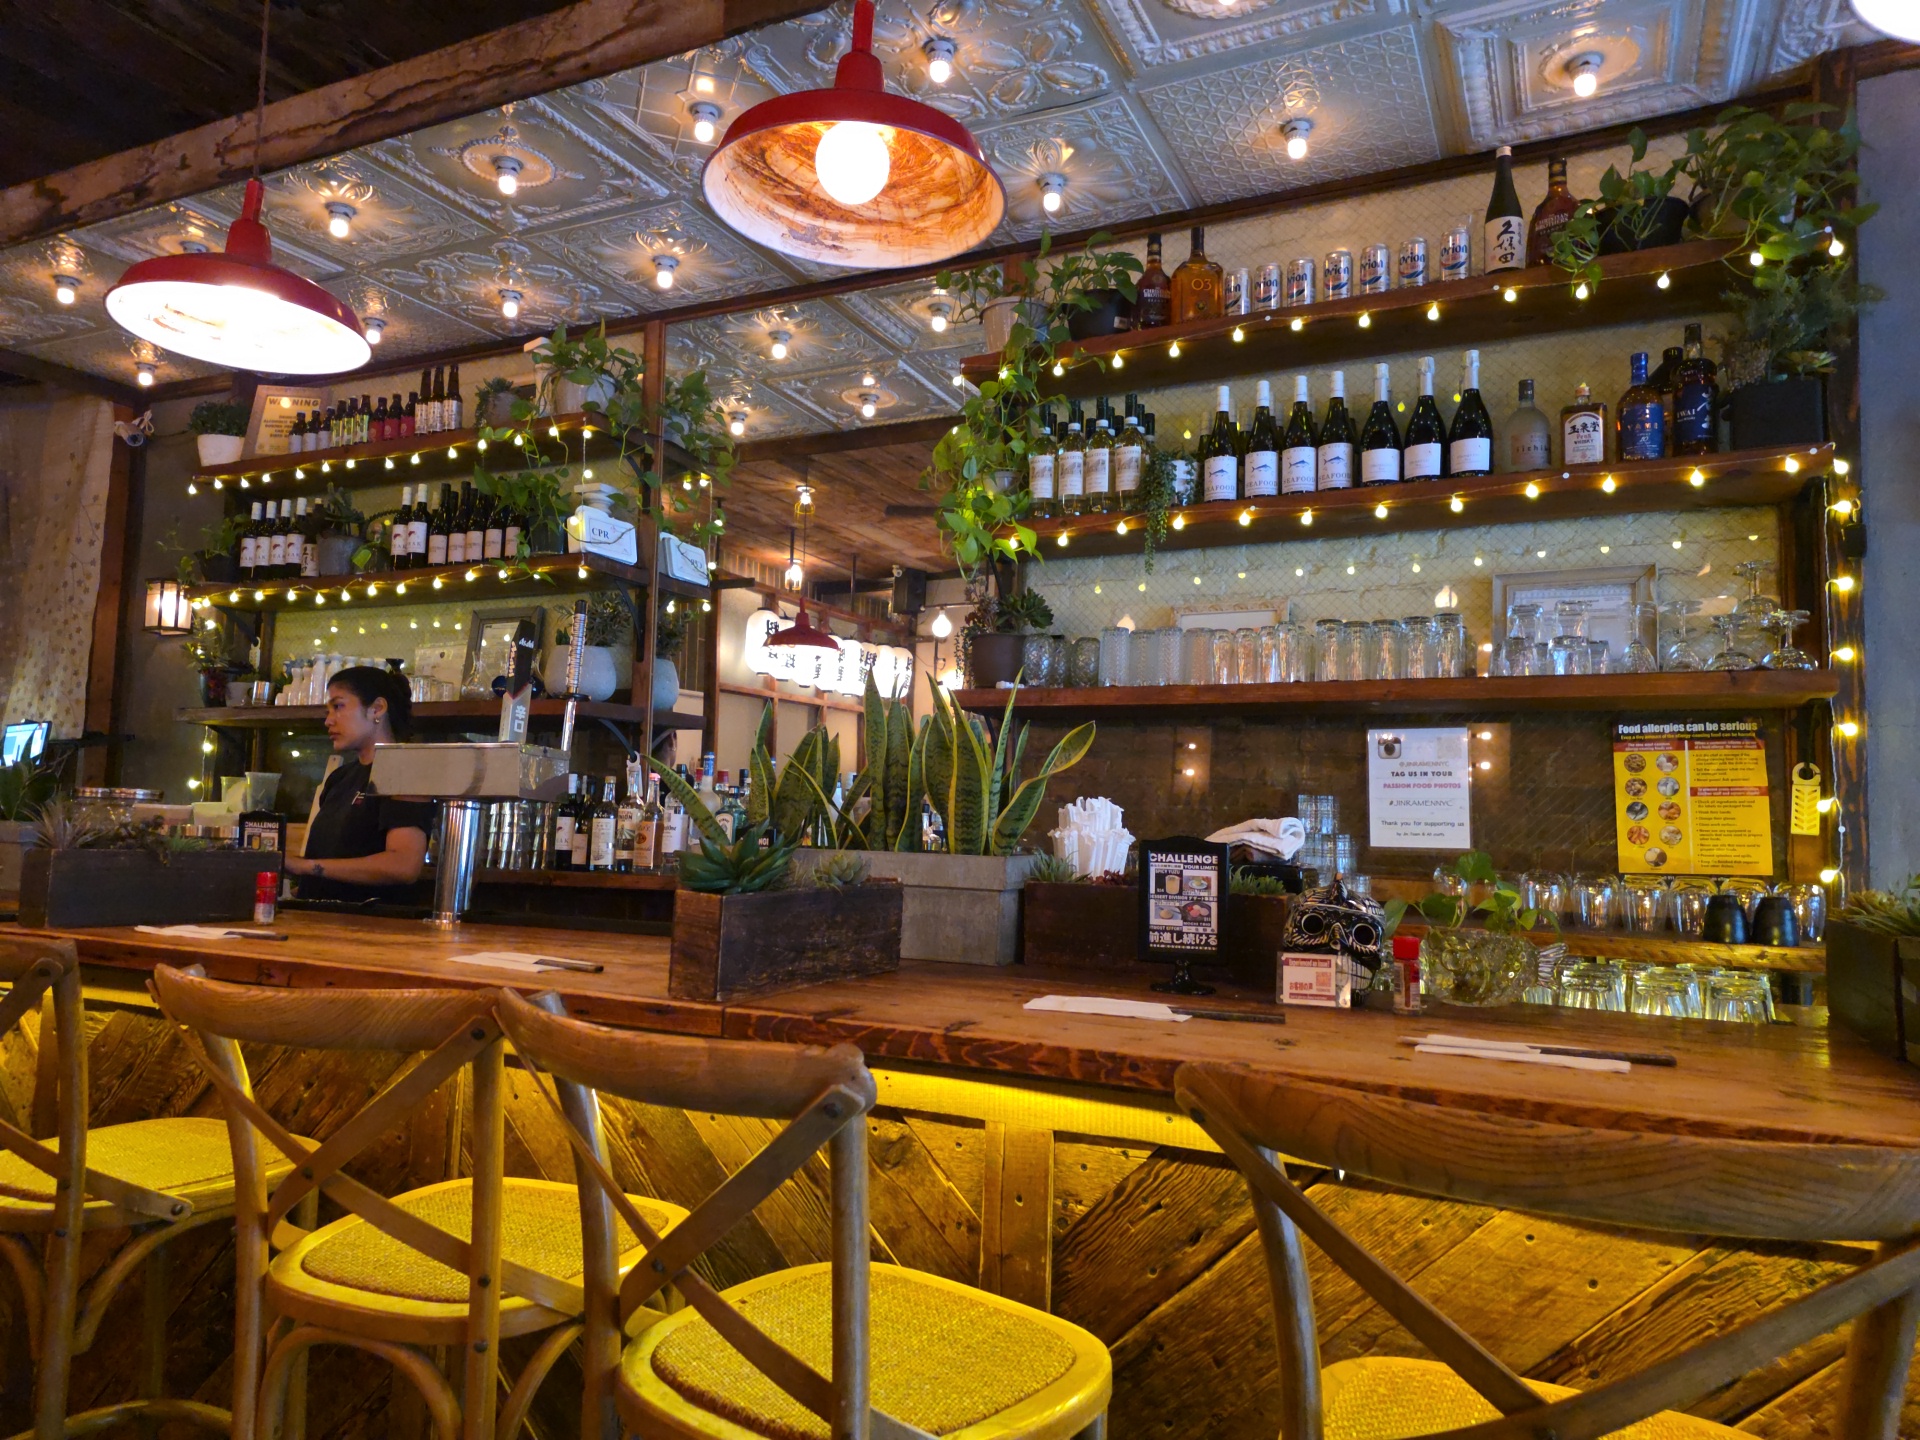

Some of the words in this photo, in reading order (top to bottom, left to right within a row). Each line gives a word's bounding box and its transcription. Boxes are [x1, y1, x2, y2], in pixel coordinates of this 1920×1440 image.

[1493, 220, 1516, 264] 久保田
[269, 398, 319, 407] WNING
[591, 527, 609, 540] CPR
[519, 637, 535, 649] Asahi
[514, 705, 526, 733] 辛口
[1618, 724, 1641, 733] Food
[1642, 723, 1685, 733] allergies
[1686, 723, 1705, 731] can
[1705, 721, 1719, 731] be
[1720, 721, 1758, 731] serious
[1149, 853, 1219, 864] CHALLENGE
[1149, 931, 1218, 945] 前進し続ける
